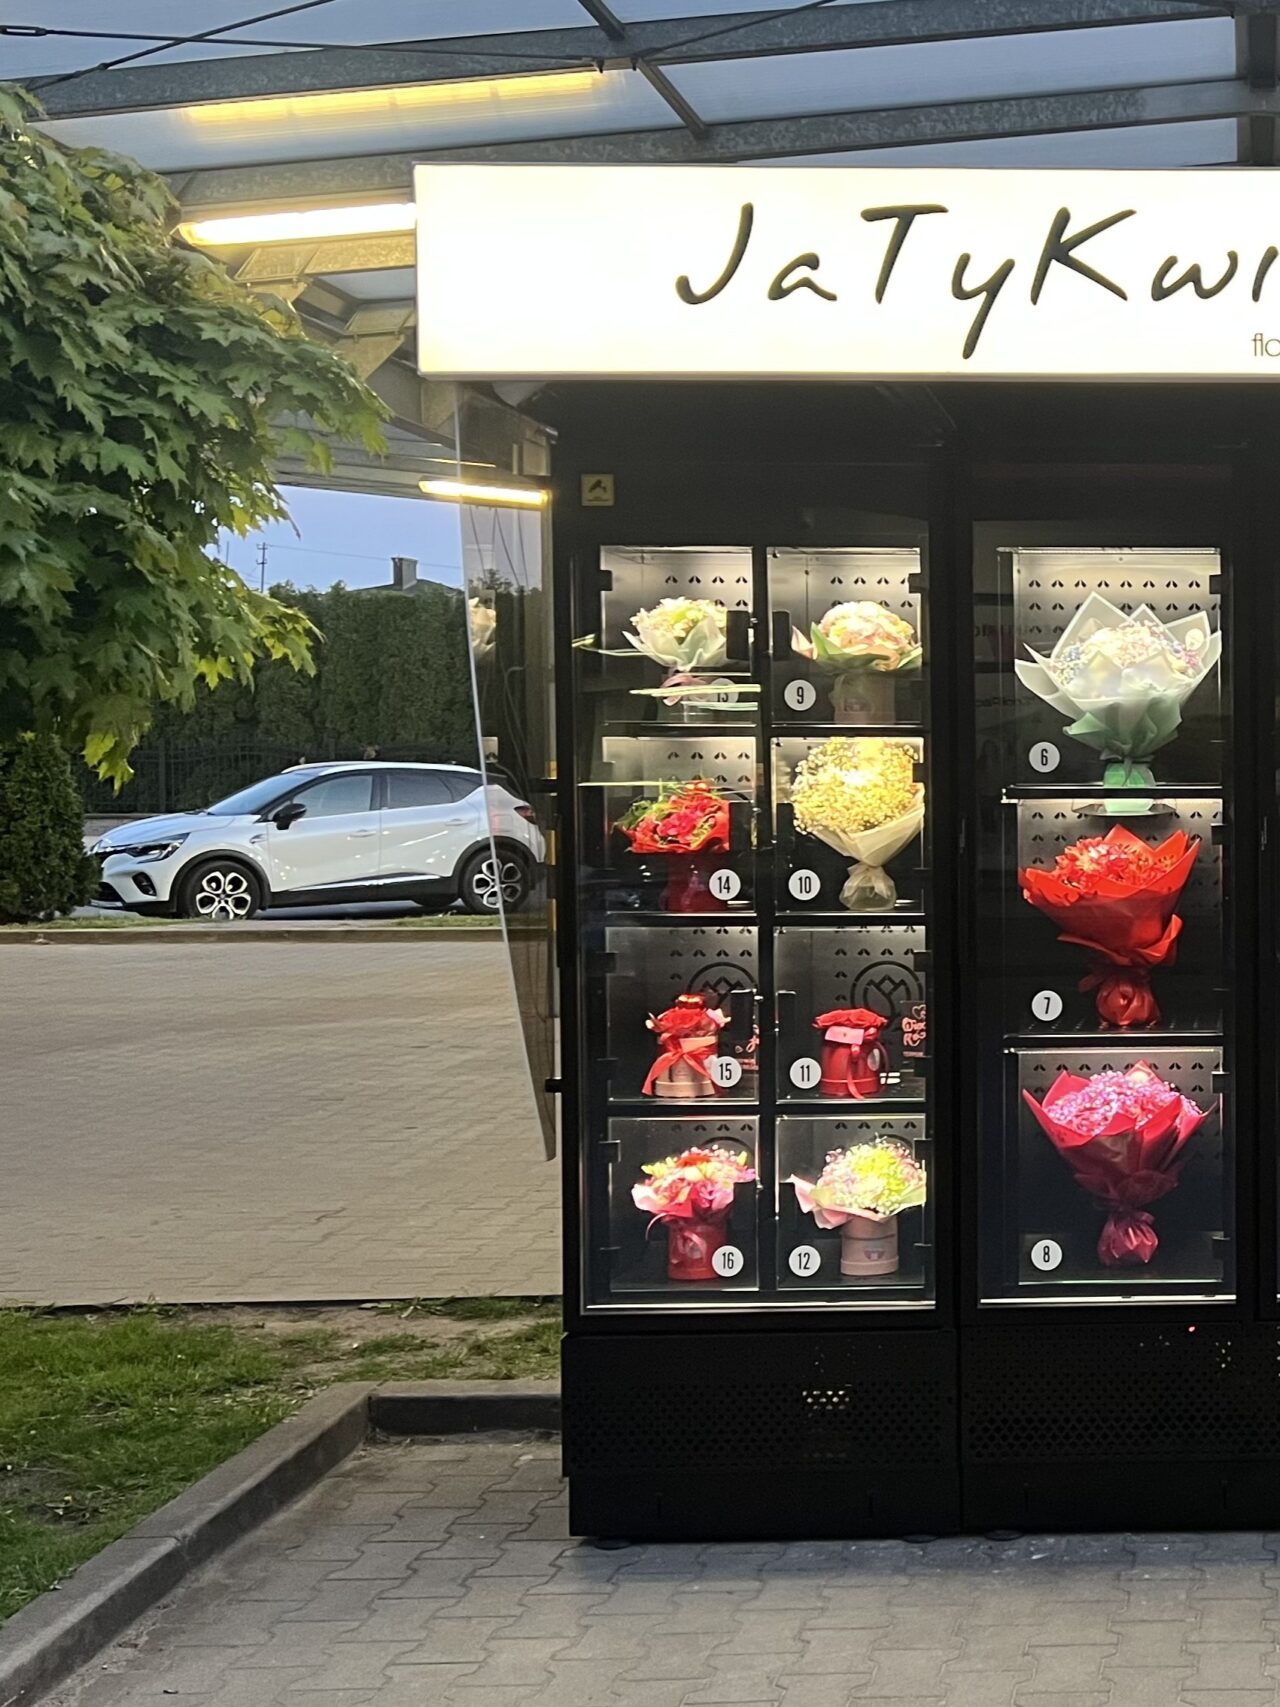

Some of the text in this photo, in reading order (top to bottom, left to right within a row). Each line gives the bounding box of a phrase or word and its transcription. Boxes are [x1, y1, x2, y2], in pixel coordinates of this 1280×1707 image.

[796, 686, 805, 704] 9
[1040, 748, 1048, 766] 6
[717, 876, 731, 893] 14
[798, 875, 811, 894] 10
[1043, 997, 1052, 1015] 7
[719, 1063, 732, 1081] 15
[799, 1064, 811, 1082] 11
[721, 1252, 735, 1270] 16
[797, 1252, 811, 1270] 12
[1043, 1246, 1051, 1264] 8
